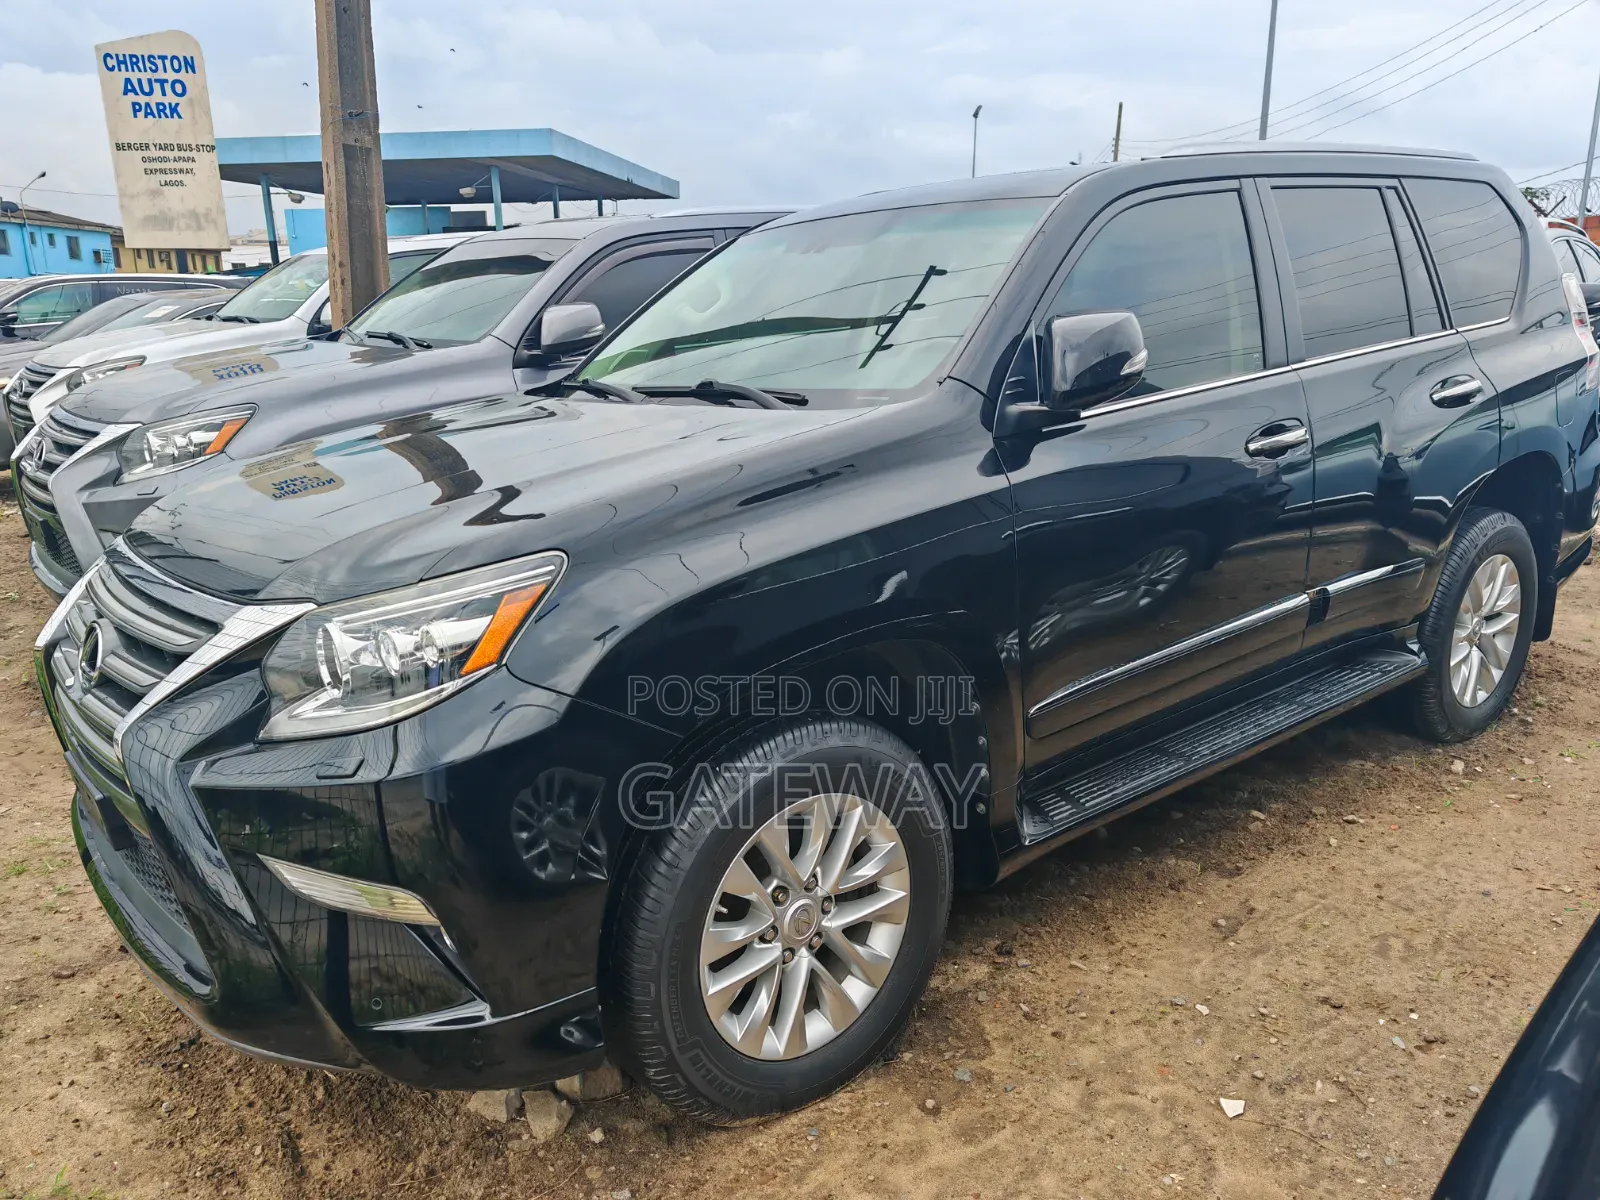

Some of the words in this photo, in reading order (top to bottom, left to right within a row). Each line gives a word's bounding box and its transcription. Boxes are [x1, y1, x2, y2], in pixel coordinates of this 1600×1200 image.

[103, 53, 196, 74] CHRISTON
[123, 77, 187, 98] AUTO
[132, 102, 182, 119] PARK
[115, 143, 151, 152] BERGER
[152, 143, 175, 152] YARD
[176, 143, 216, 153] BUS-STOP
[142, 156, 196, 164] OSHODI-APAPA
[144, 168, 195, 176] EXPRESSWAY,
